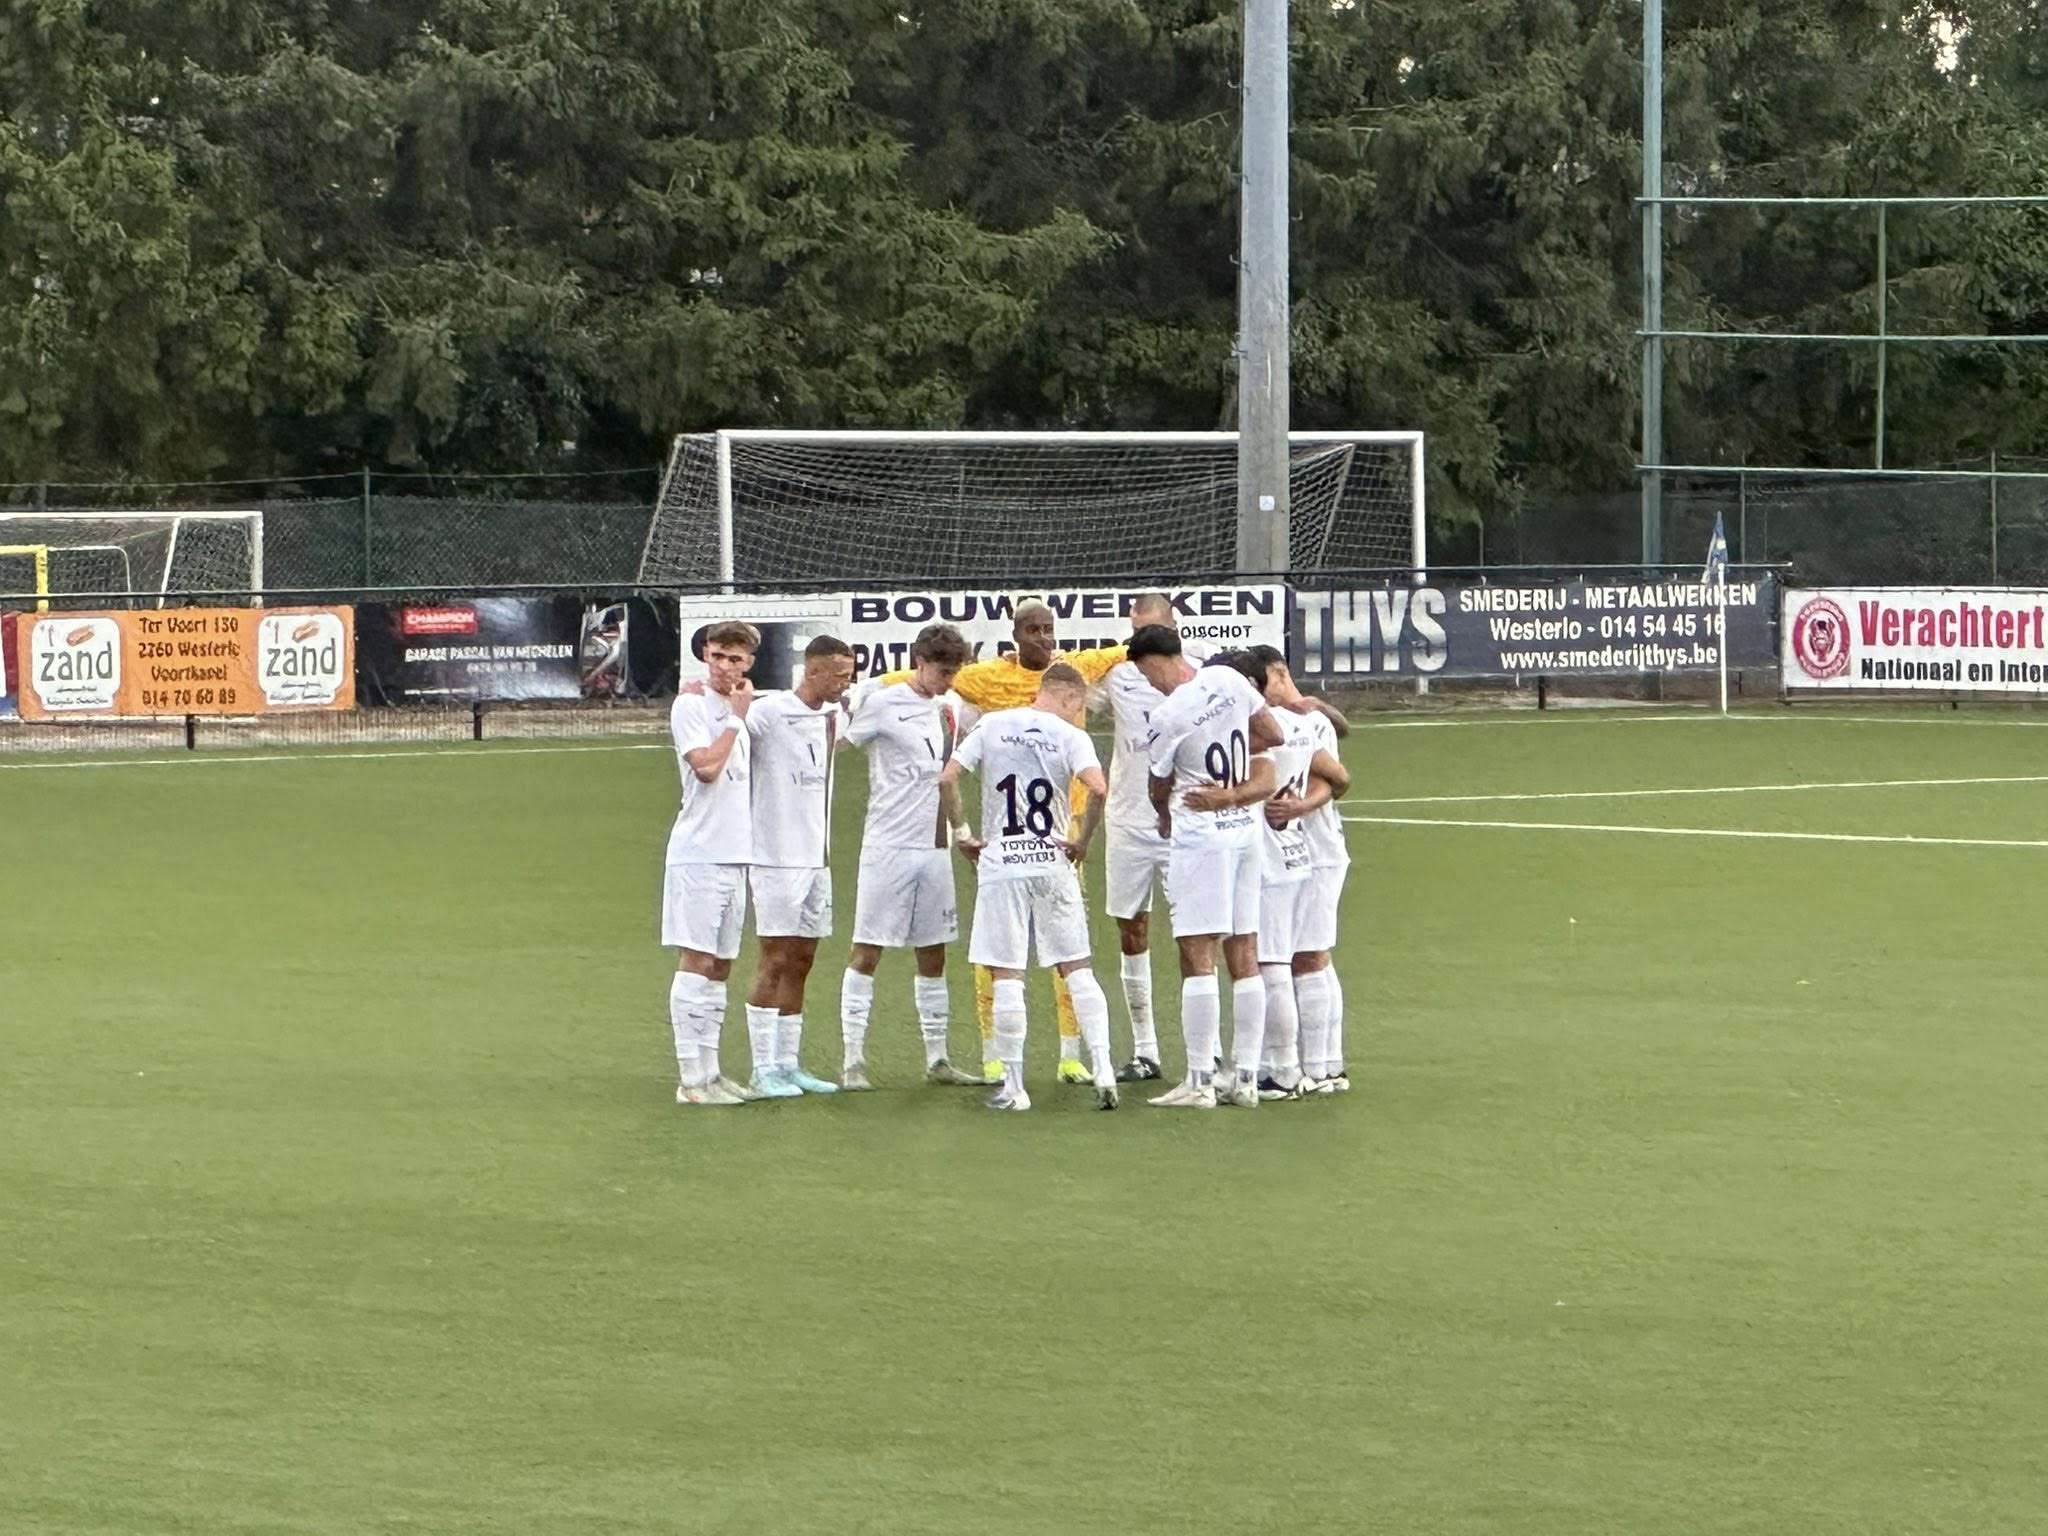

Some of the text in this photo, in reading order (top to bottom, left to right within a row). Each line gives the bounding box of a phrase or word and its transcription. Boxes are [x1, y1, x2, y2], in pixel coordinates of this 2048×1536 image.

[1460, 588, 1567, 612] SMEDERIJ
[1585, 584, 1757, 609] METAALWERKEN
[1181, 625, 1252, 640] OISCHOT
[1296, 588, 1447, 672] THYS
[1490, 616, 1582, 641] Westerlo
[1600, 615, 1636, 638] 014
[1643, 614, 1666, 637] 54
[1672, 614, 1697, 636] 45
[1859, 601, 2044, 649] Verachtert
[40, 640, 113, 682] zand
[266, 636, 336, 677] zand
[1501, 642, 1718, 671] www.smederijthys.be
[1861, 658, 1961, 681] Nationaal
[1968, 663, 1993, 682] en
[1205, 729, 1246, 789] 90
[996, 773, 1053, 838] 18
